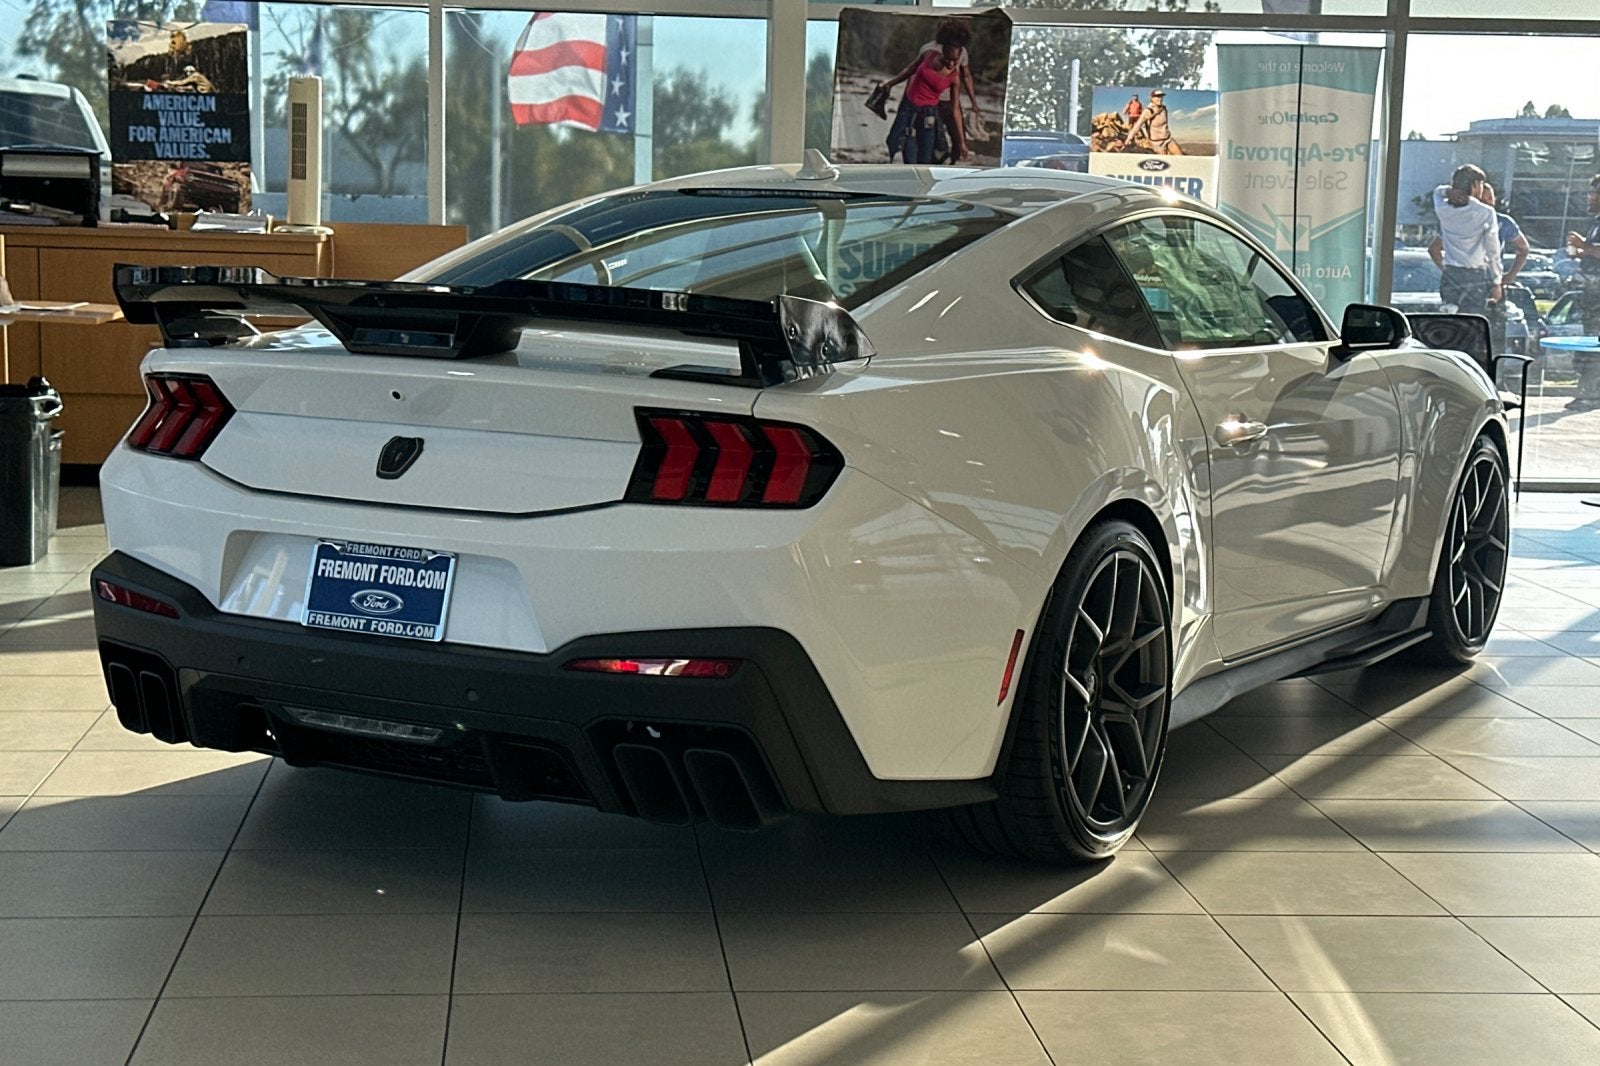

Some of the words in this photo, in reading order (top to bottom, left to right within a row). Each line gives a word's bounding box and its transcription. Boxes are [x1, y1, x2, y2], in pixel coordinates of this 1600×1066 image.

[142, 94, 216, 111] AMERICAN
[158, 111, 205, 127] VALUE.
[128, 126, 157, 142] FOR
[159, 127, 232, 143] AMERICAN
[154, 143, 211, 159] VALUES.
[347, 543, 393, 556] FREMONT
[393, 549, 420, 560] FORD
[317, 558, 378, 582] FREMONT
[379, 565, 446, 590] FORD.COM
[309, 613, 366, 630] FREMONT
[370, 620, 434, 638] FORD.COM
